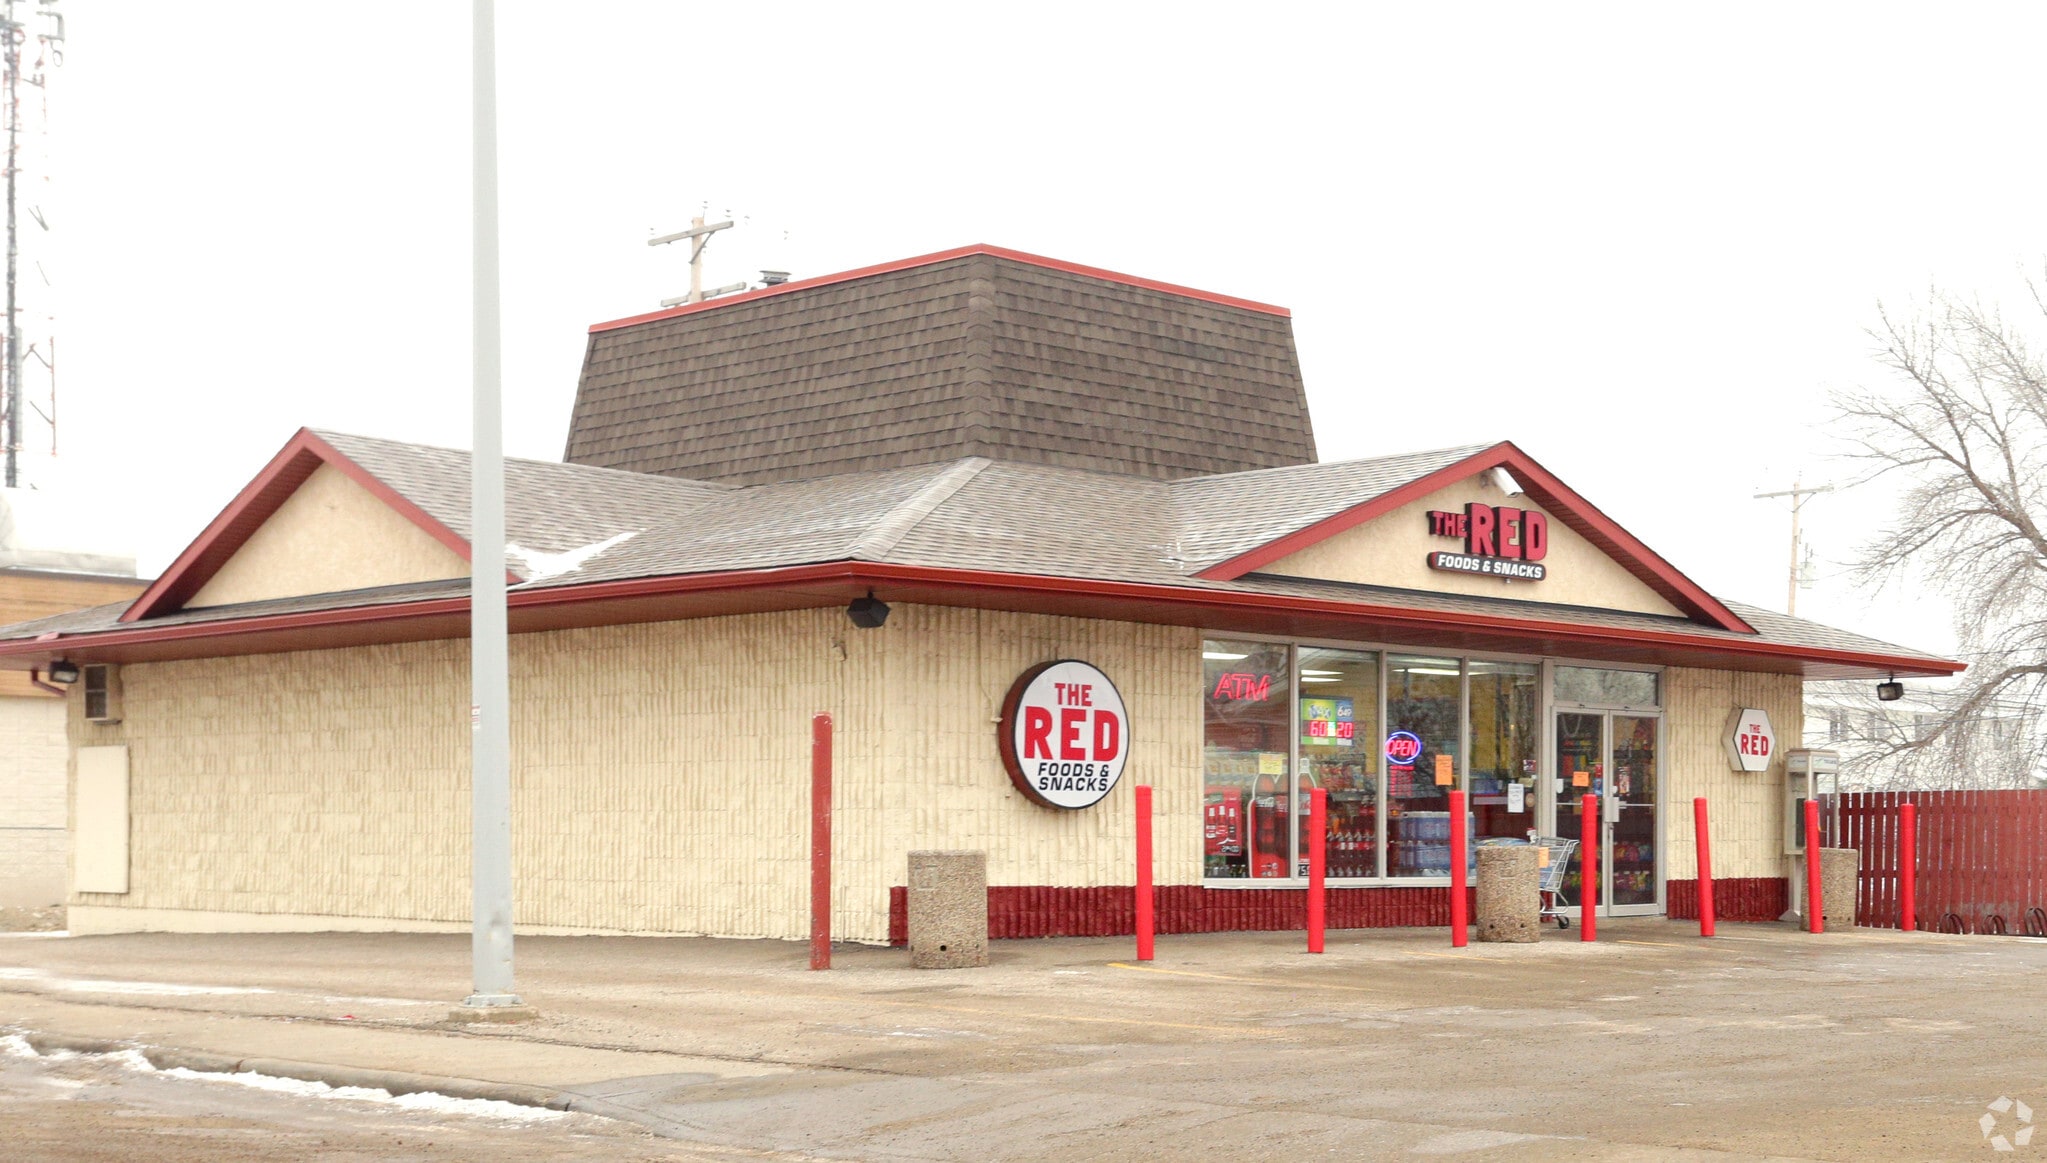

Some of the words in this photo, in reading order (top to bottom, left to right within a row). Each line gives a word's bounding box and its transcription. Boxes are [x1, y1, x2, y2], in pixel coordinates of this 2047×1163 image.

[1427, 511, 1468, 538] THE
[1465, 502, 1547, 560] RED
[1438, 554, 1480, 571] FOODS
[1482, 559, 1491, 573] &
[1493, 561, 1543, 579] SNACKS
[1054, 683, 1092, 706] THE
[1214, 673, 1271, 701] ATM
[1024, 706, 1119, 761] RED
[1336, 721, 1354, 738] 20
[1749, 724, 1760, 733] THE
[1386, 740, 1416, 756] OPEN
[1741, 734, 1768, 756] RED
[1038, 763, 1094, 777] FOODS
[1100, 765, 1109, 777] &
[1039, 777, 1108, 791] SNACKS
